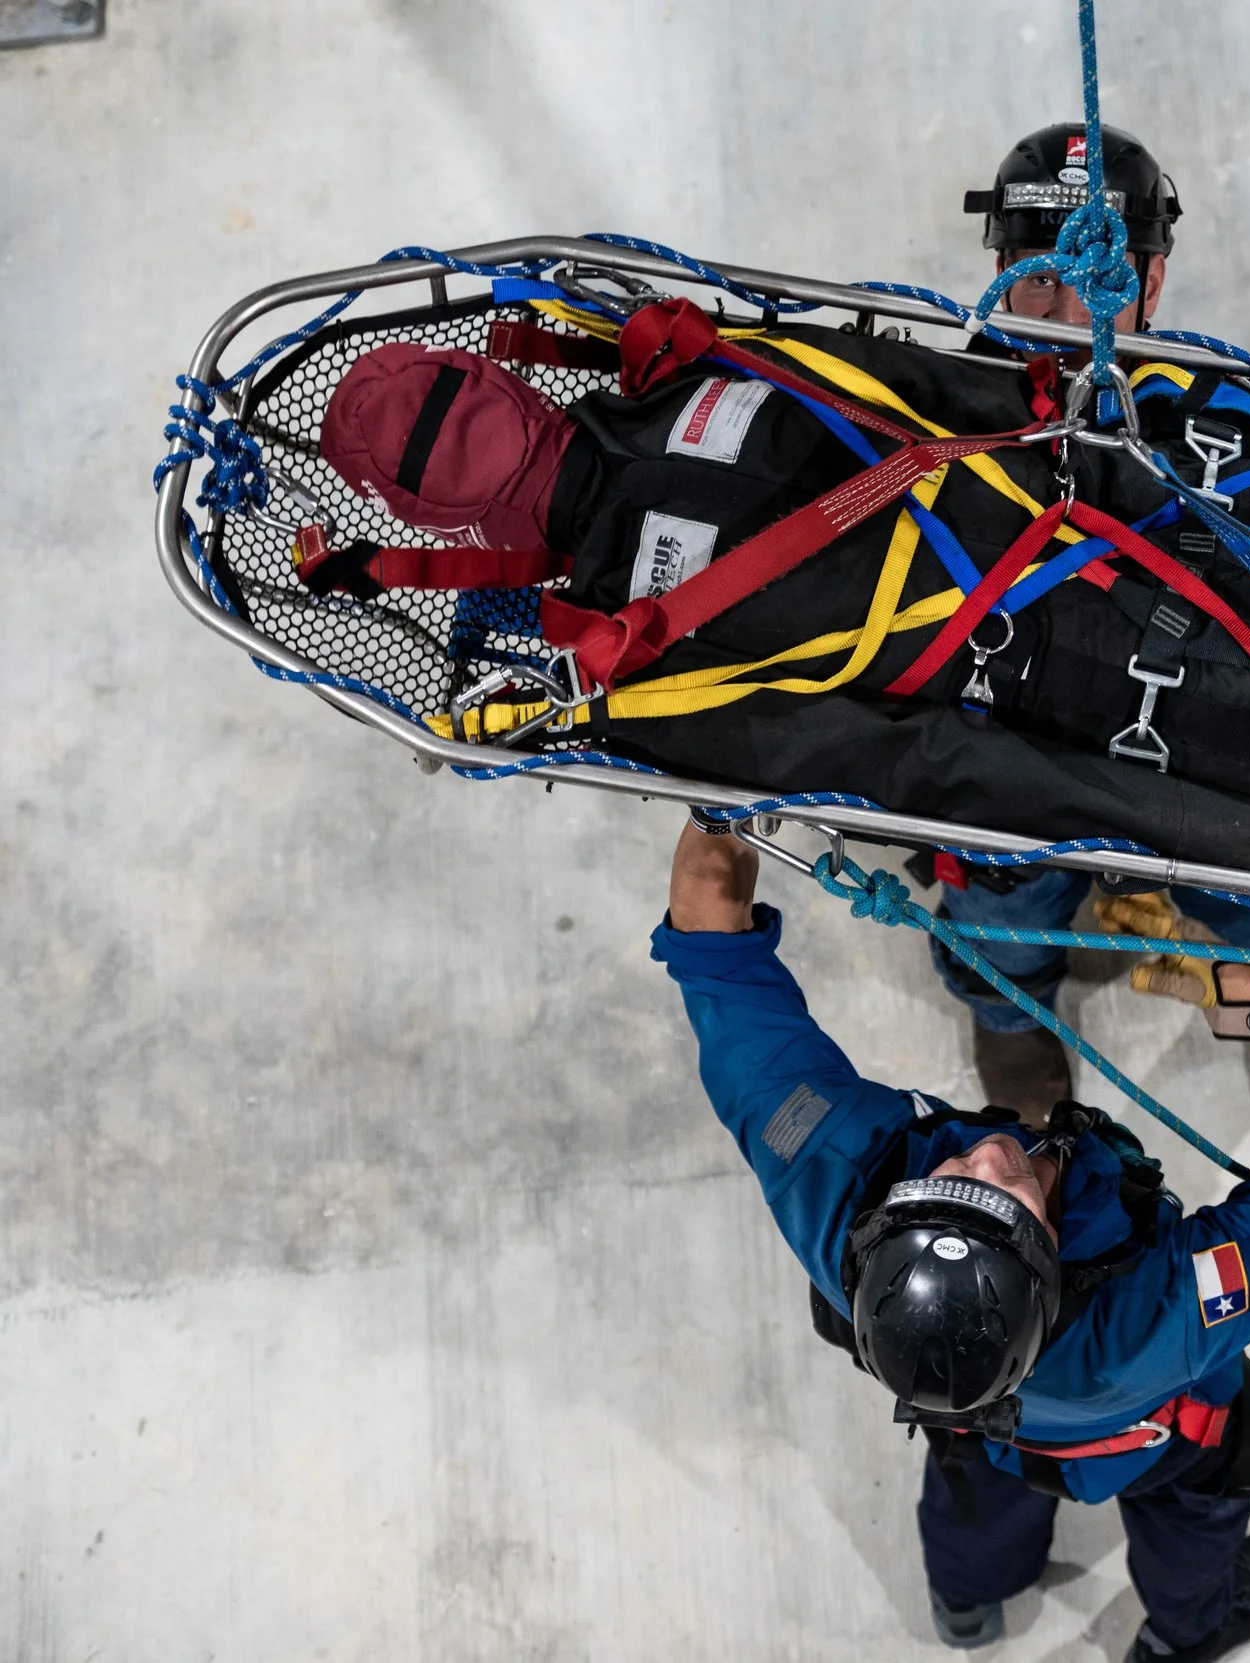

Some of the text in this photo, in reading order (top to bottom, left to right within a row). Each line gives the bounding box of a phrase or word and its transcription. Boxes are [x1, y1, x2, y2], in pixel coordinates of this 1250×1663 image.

[1069, 173, 1087, 181] CMC
[686, 403, 713, 439] RUTH
[708, 382, 725, 402] LEE
[647, 534, 674, 599] SCUE
[936, 1243, 956, 1253] CMC
